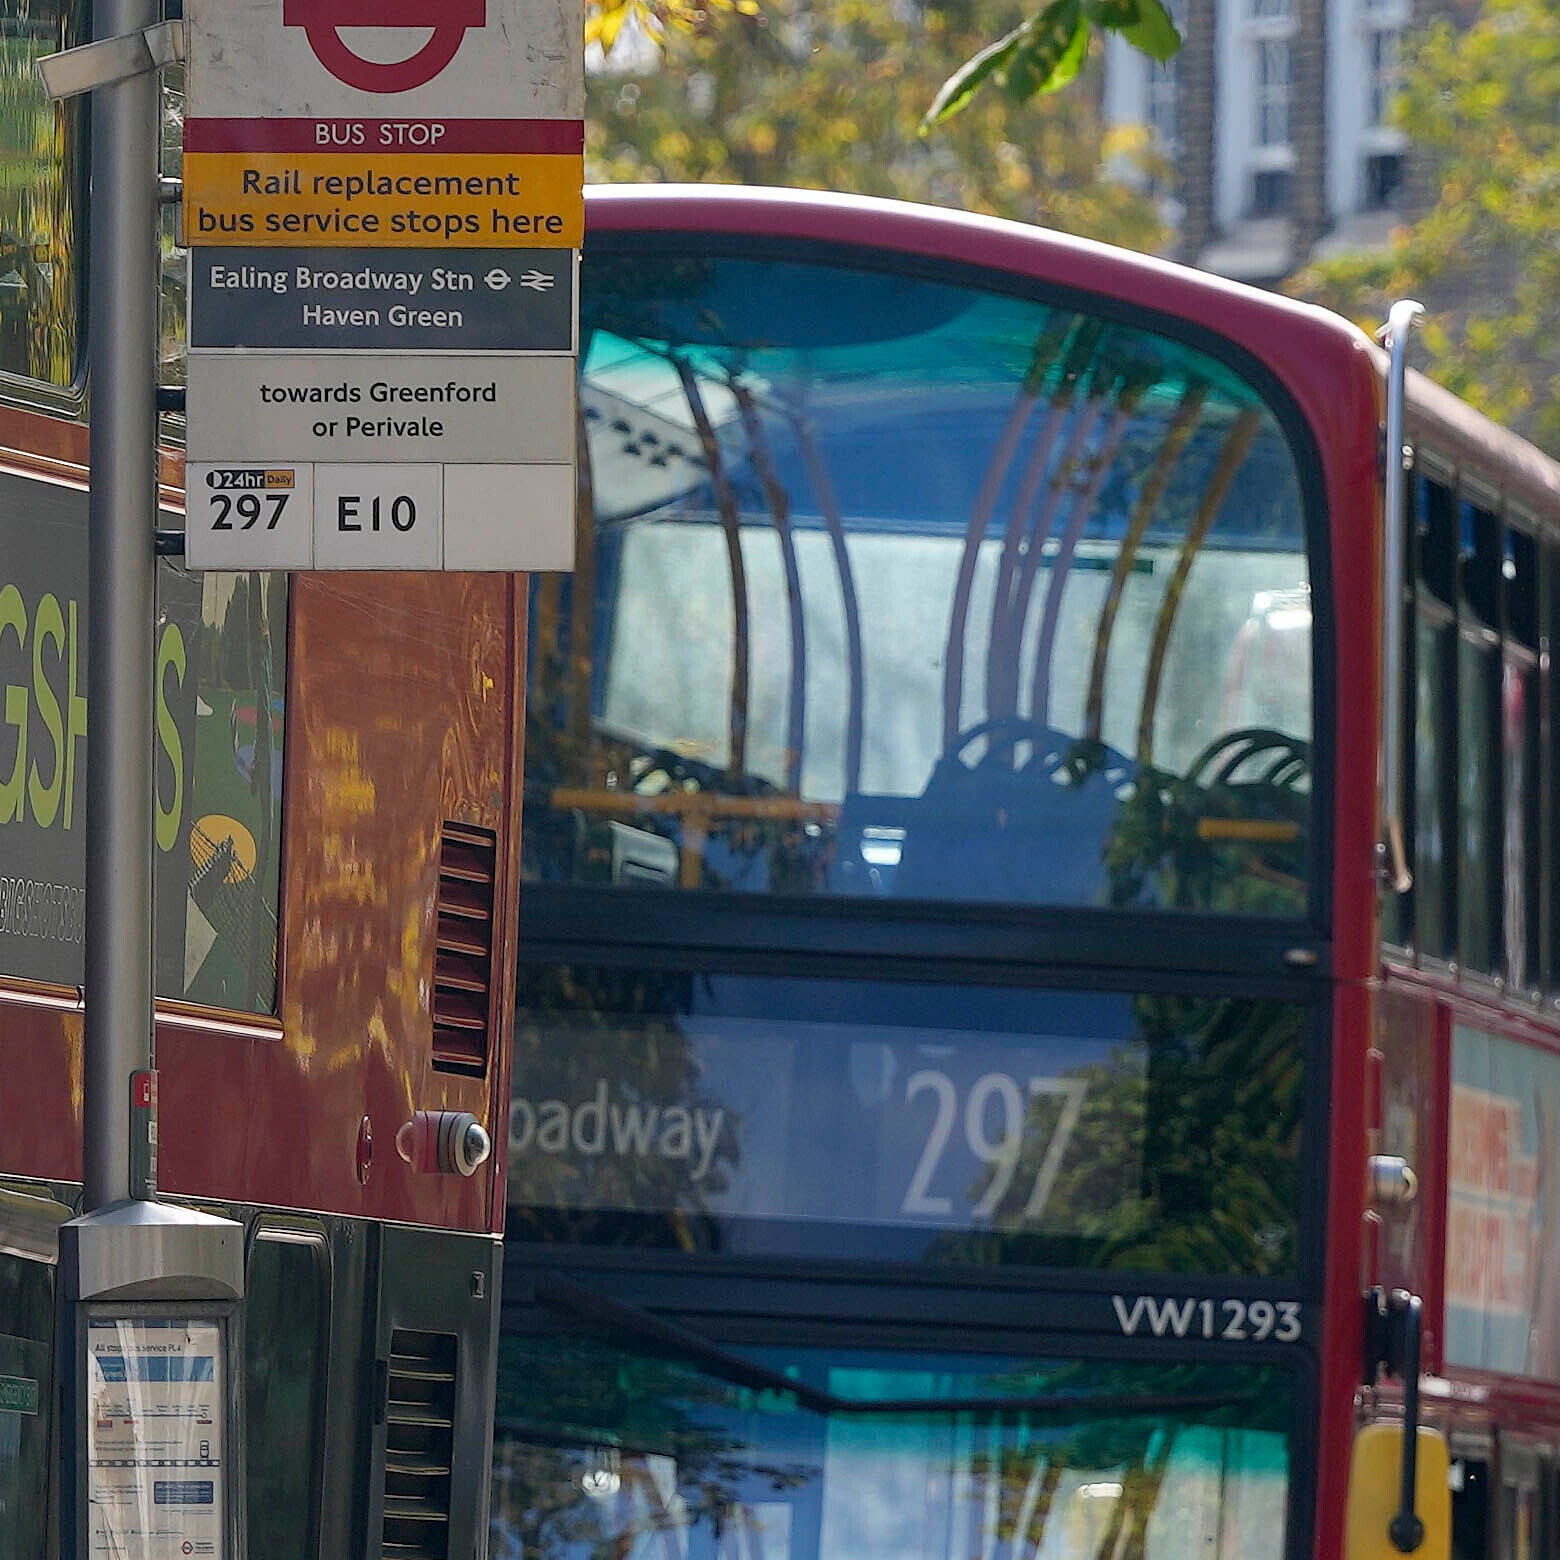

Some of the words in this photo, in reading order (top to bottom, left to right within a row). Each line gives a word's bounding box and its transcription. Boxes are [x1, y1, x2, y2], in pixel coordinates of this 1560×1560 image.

[315, 124, 365, 146] BUS
[379, 124, 446, 146] STOP
[242, 169, 302, 196] Rail
[313, 171, 520, 200] replacement
[198, 208, 254, 233] bus
[266, 209, 379, 234] service
[391, 210, 480, 239] stops
[492, 208, 564, 234] here
[209, 266, 289, 295] Ealing
[295, 267, 423, 296] Broadway
[431, 268, 474, 291] Stn
[302, 305, 379, 328] Haven
[388, 305, 464, 328] Green
[260, 382, 362, 404] towards
[369, 381, 497, 404] Greenford
[312, 419, 339, 437] or
[346, 417, 444, 438] Perivale
[223, 472, 264, 488] 24hr
[267, 475, 292, 486] Daily
[210, 493, 291, 530] 297
[338, 495, 417, 532] E10
[899, 1070, 1095, 1219] 297
[1111, 1292, 1303, 1344] VW1293
